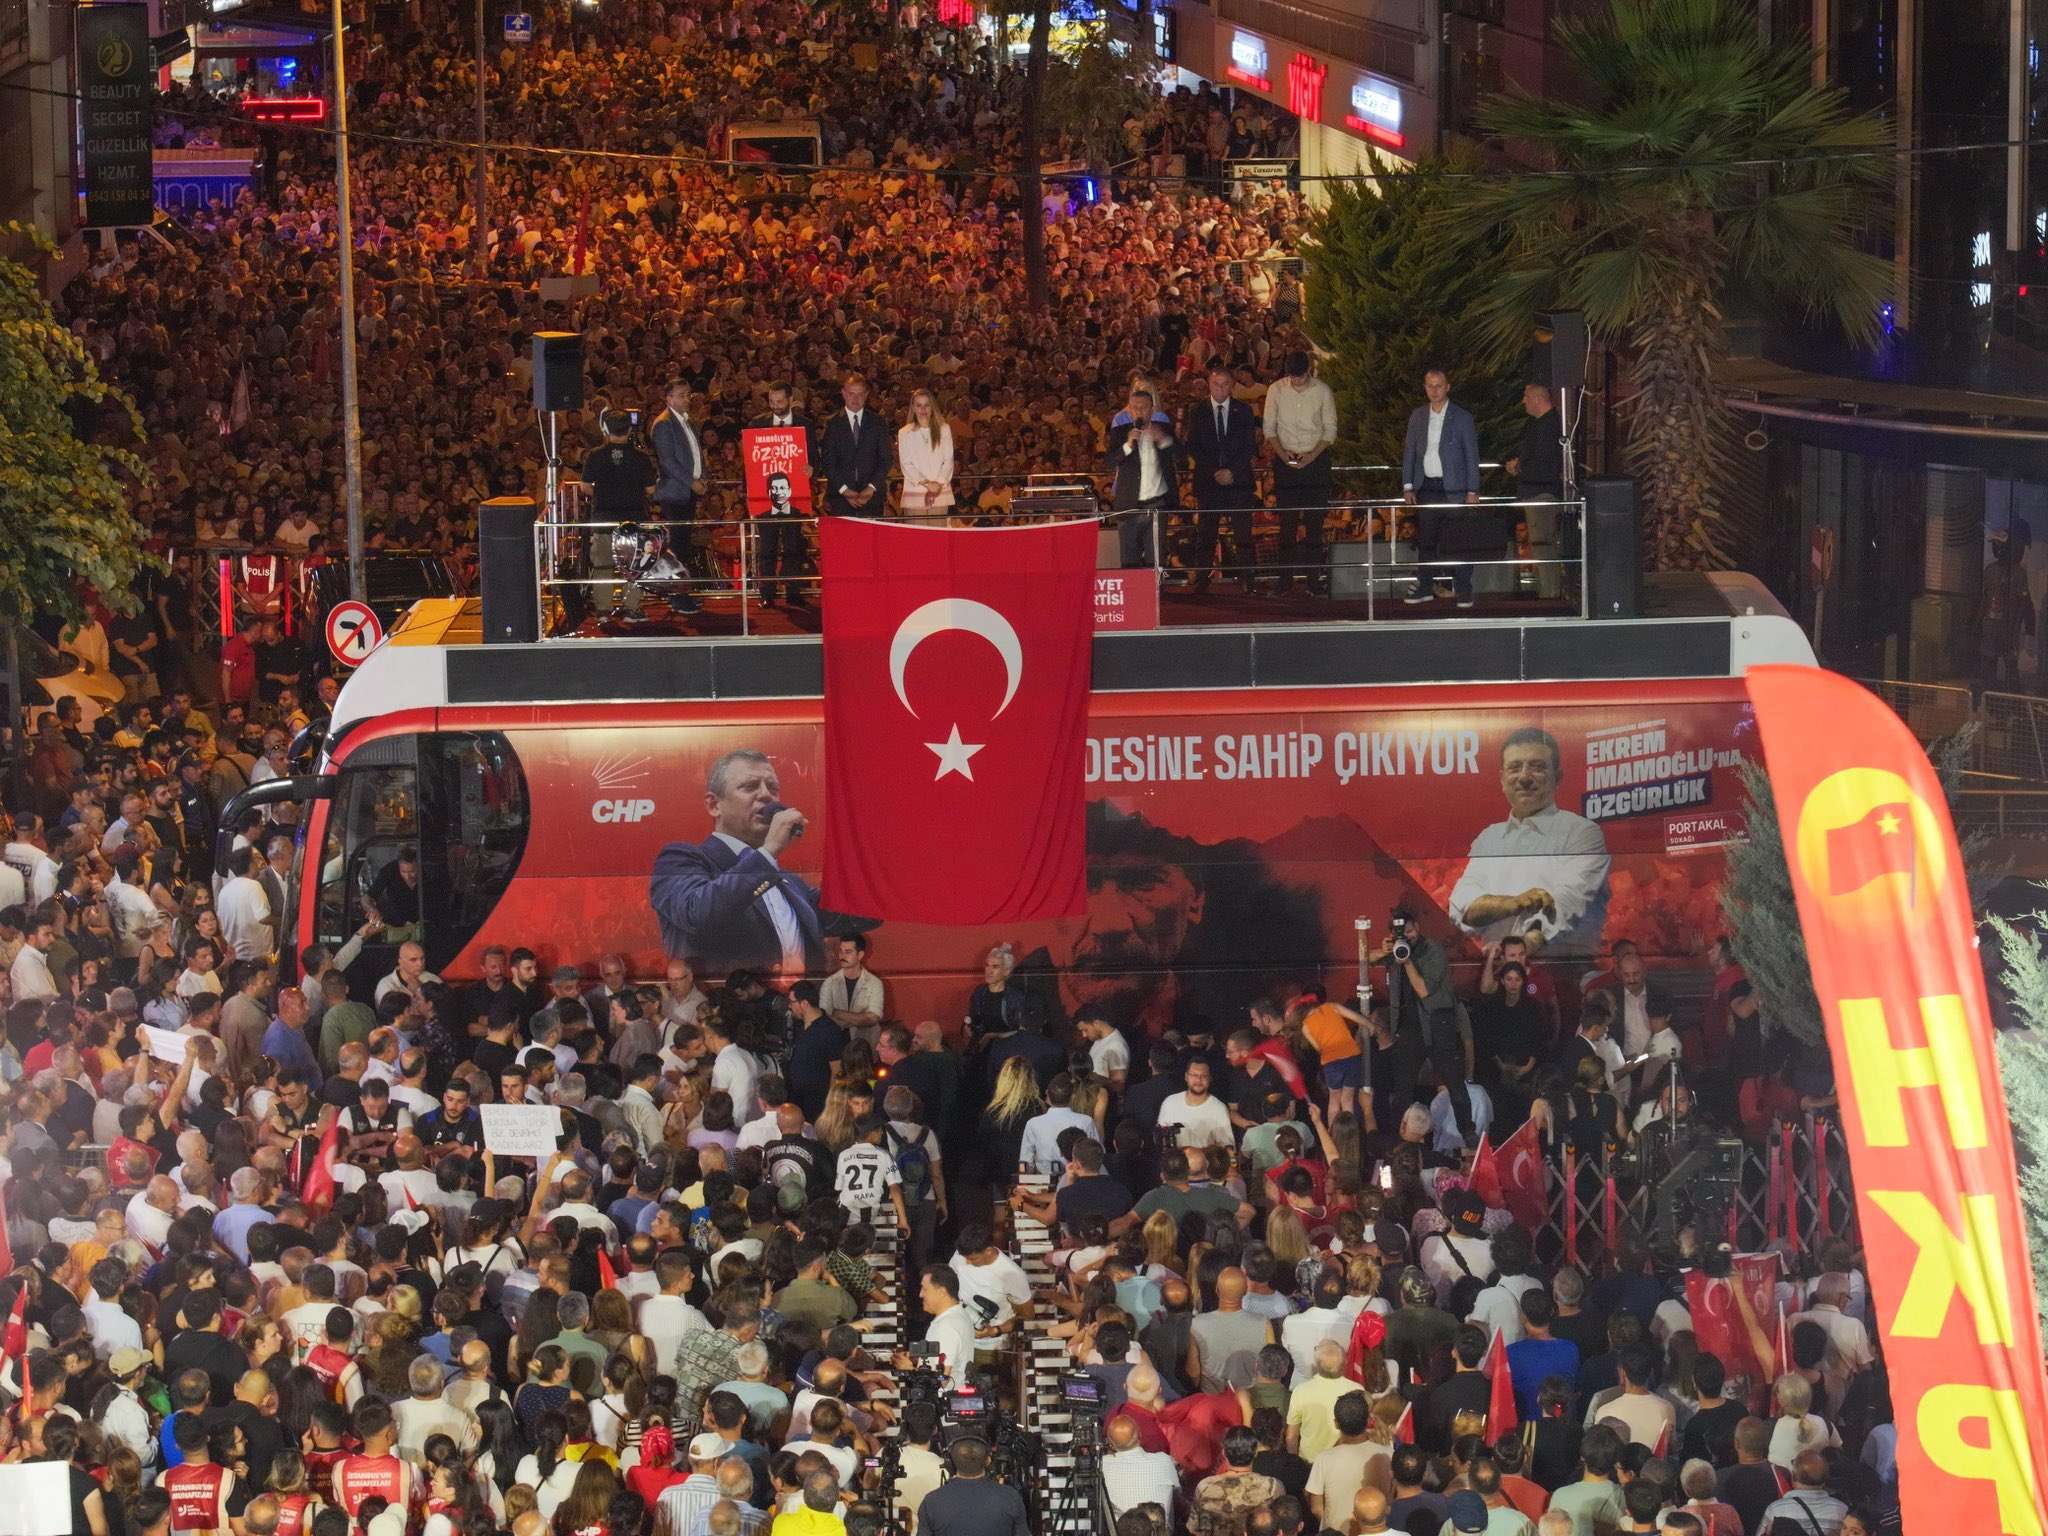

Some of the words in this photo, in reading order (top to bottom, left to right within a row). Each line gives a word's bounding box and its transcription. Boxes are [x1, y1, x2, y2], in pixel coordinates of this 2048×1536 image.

[90, 84, 141, 99] BEAUTY
[92, 111, 141, 126] SECRET
[752, 442, 804, 463] ÖZGÜR-
[1214, 732, 1323, 780] SAHİP
[1334, 730, 1480, 785] ÇIKIYOR
[1586, 730, 1666, 764] EKREM
[1586, 748, 1743, 791] İMAMOĞLU'NA
[592, 799, 655, 824] CHP
[1585, 778, 1706, 820] ÖZGÜRLÜK
[1669, 818, 1727, 835] PORTAKAL
[845, 1164, 878, 1191] 27
